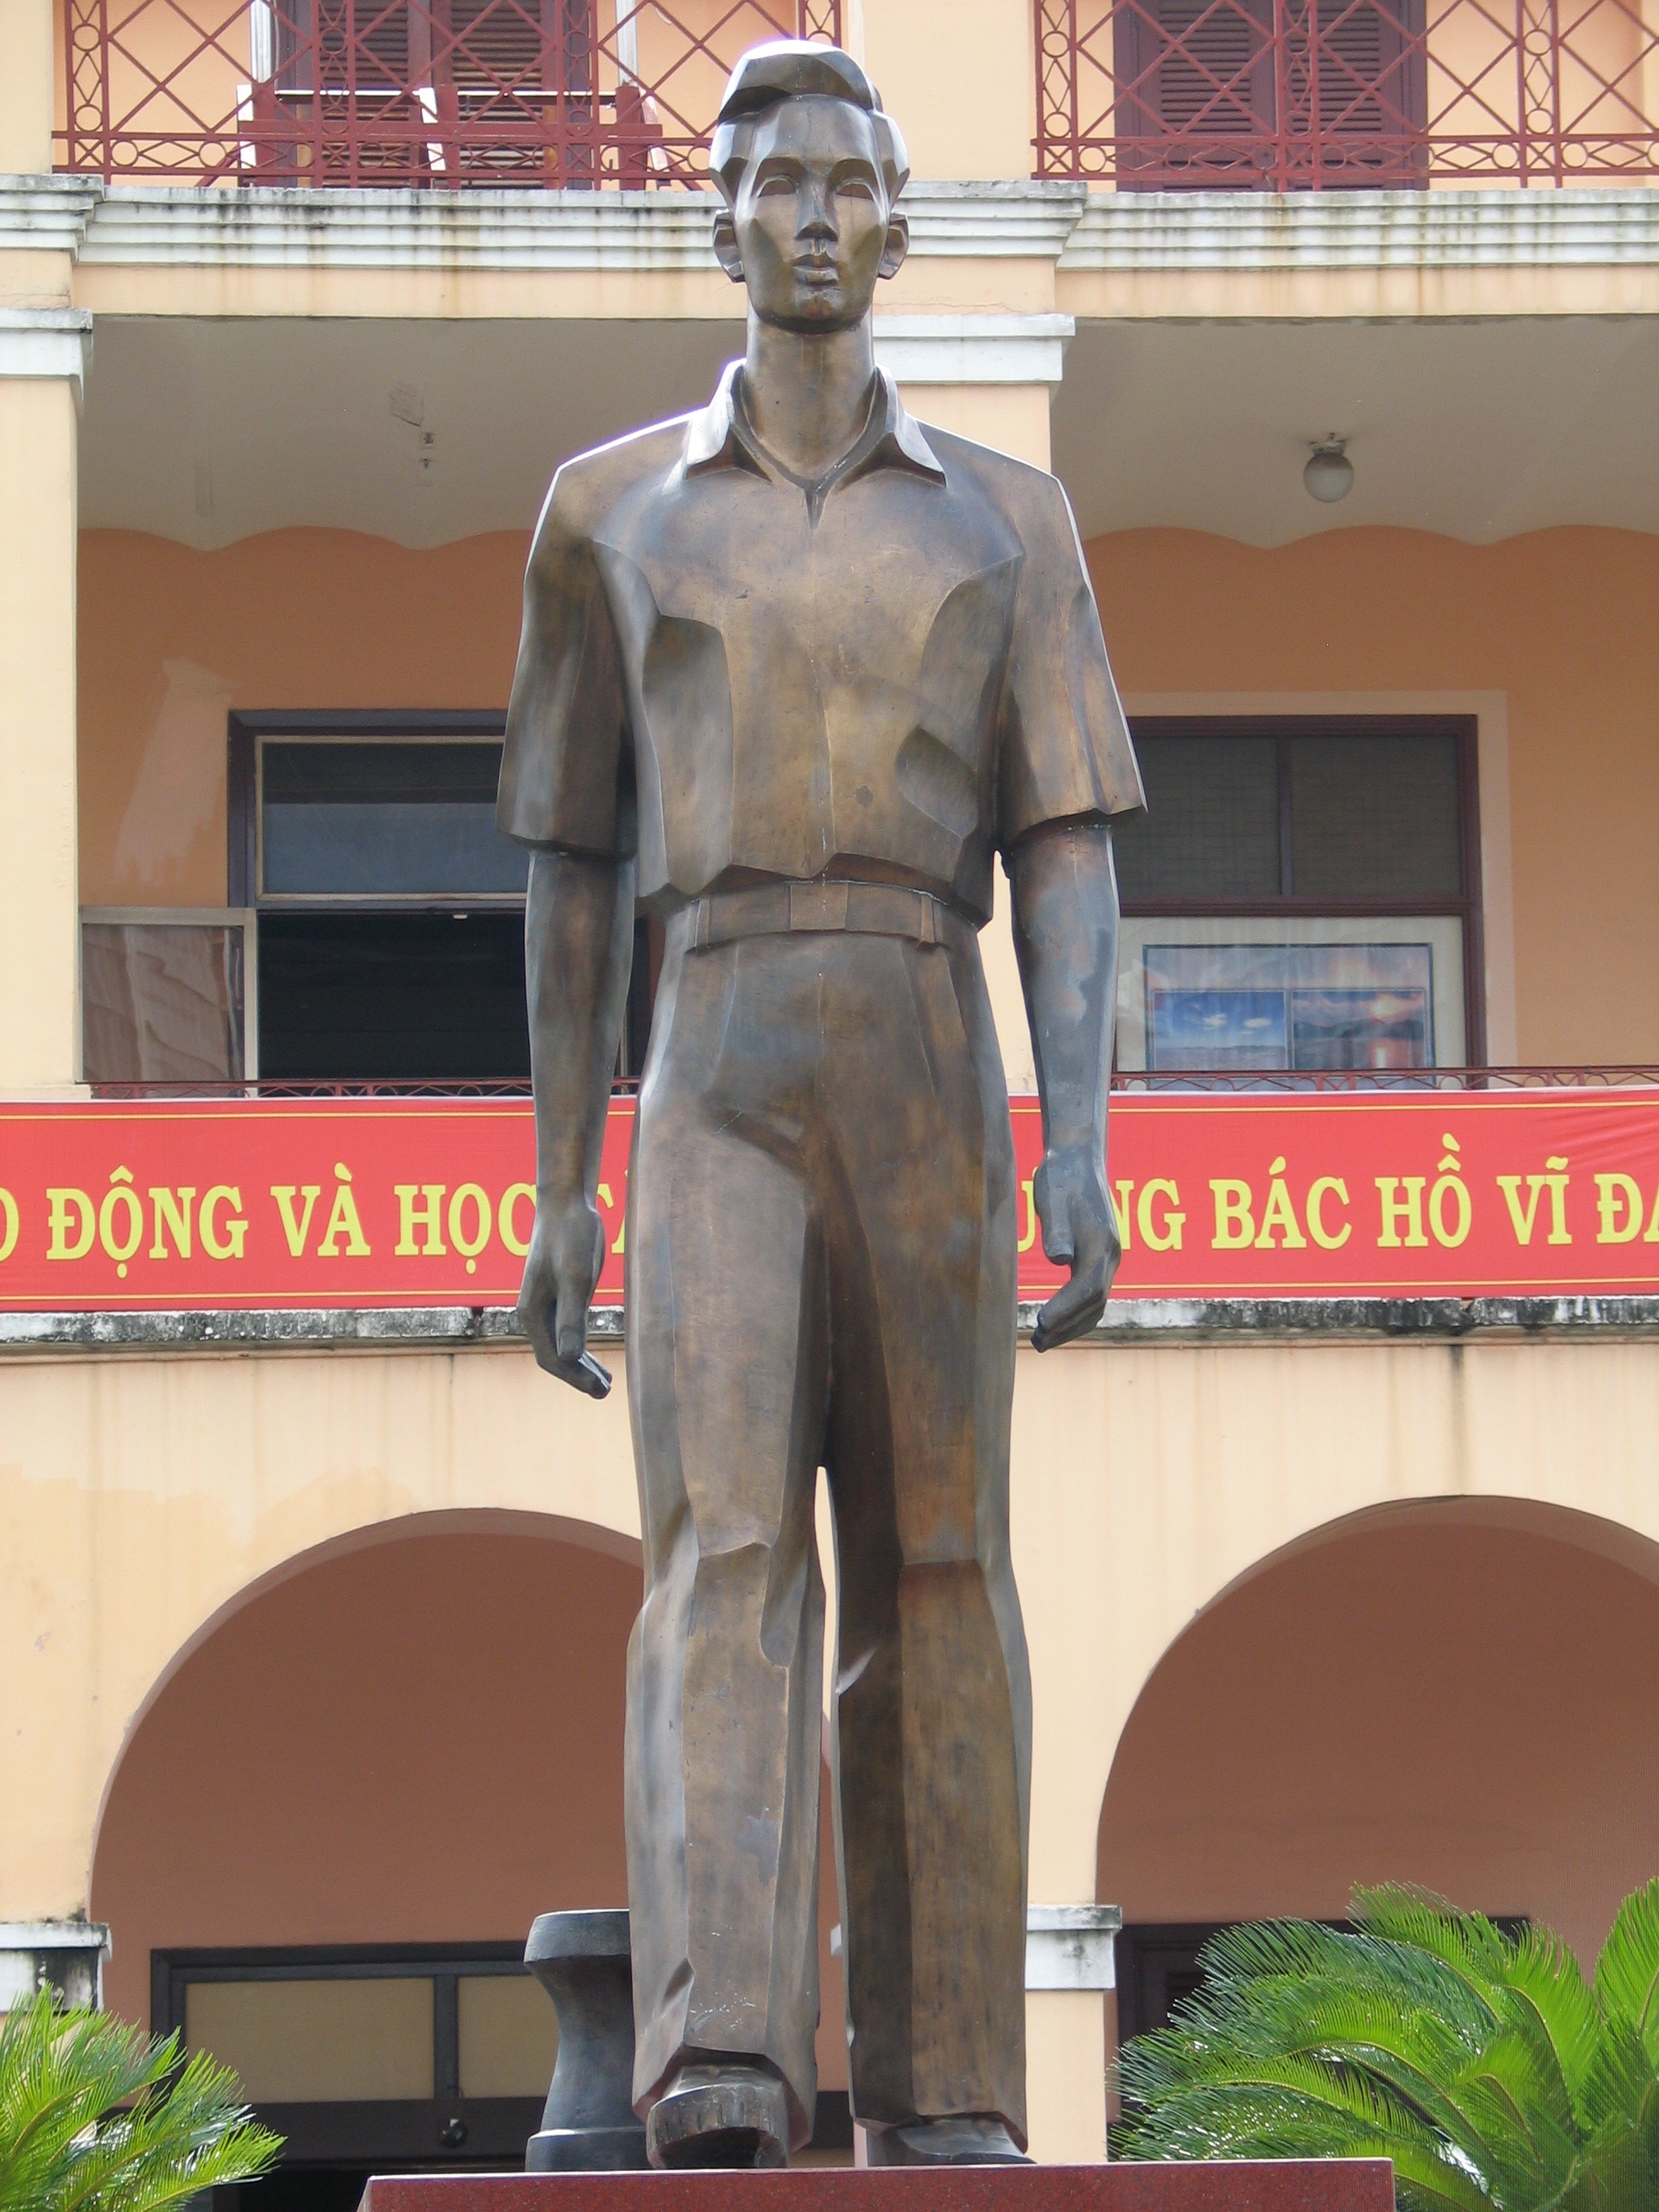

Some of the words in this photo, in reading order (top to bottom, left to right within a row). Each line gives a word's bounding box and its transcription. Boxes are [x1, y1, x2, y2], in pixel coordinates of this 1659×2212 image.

[45, 1165, 249, 1279] ĐỘNG
[270, 1161, 371, 1258] VÀ
[393, 1182, 538, 1275] HỌC
[1208, 1155, 1352, 1250] BÁC
[1374, 1132, 1472, 1249] HỒ
[1496, 1155, 1573, 1245] VĨ
